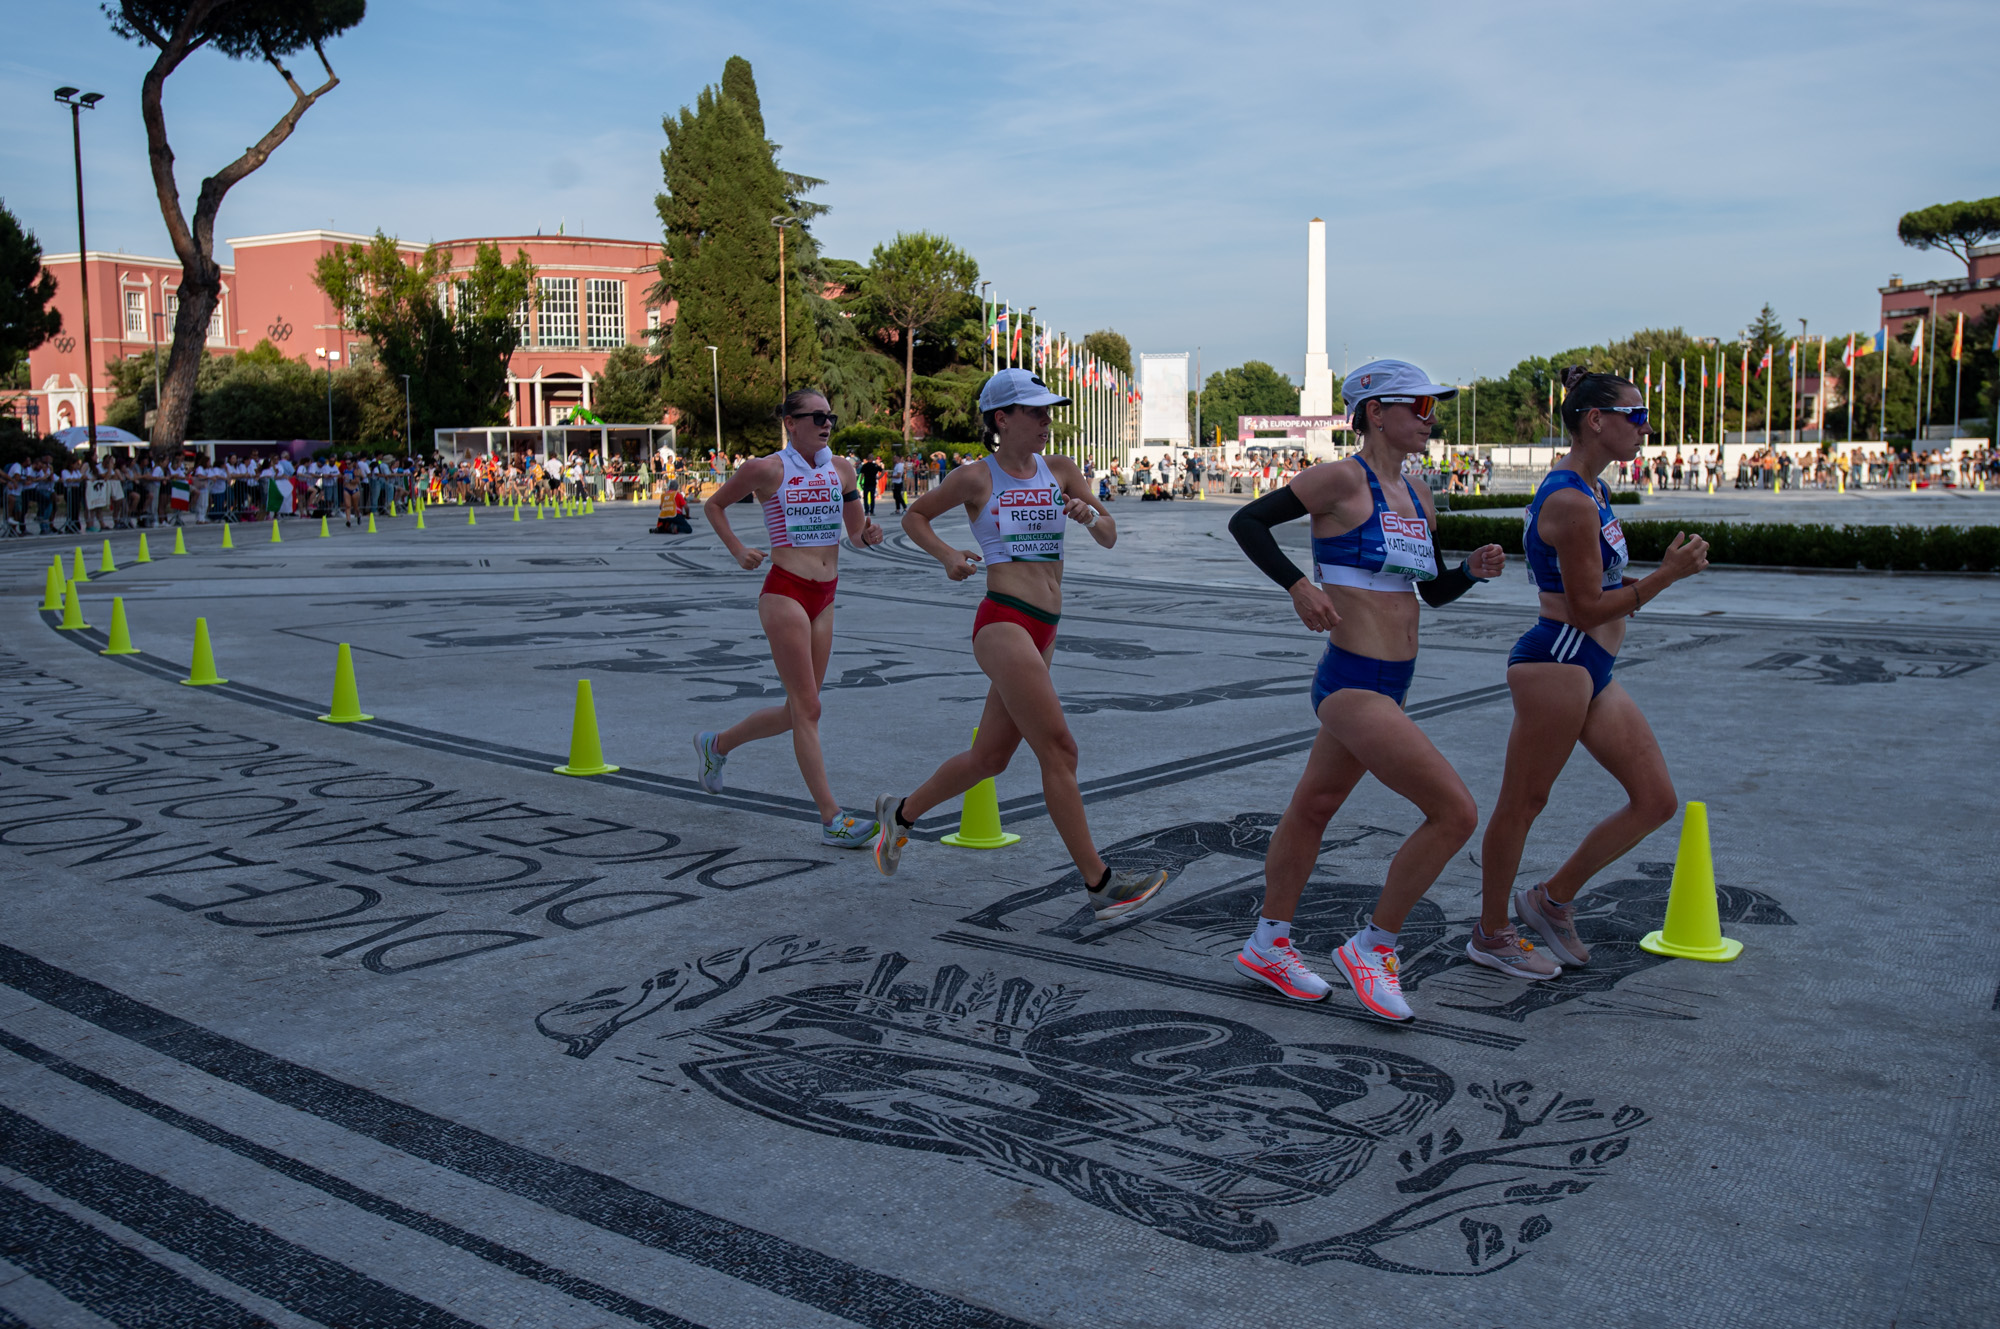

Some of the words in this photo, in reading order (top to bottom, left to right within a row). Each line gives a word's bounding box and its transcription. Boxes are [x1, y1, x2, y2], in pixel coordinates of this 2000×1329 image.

[1270, 420, 1312, 428] EUROPEAN
[788, 476, 804, 485] 4F
[787, 490, 829, 502] SPAR
[1001, 491, 1050, 504] SPAR
[786, 505, 840, 516] CHOJECKA
[1028, 523, 1041, 531] 116
[795, 533, 819, 541] ROMA
[821, 532, 835, 540] 2024
[1012, 544, 1039, 552] ROMA
[1040, 542, 1059, 551] 2024
